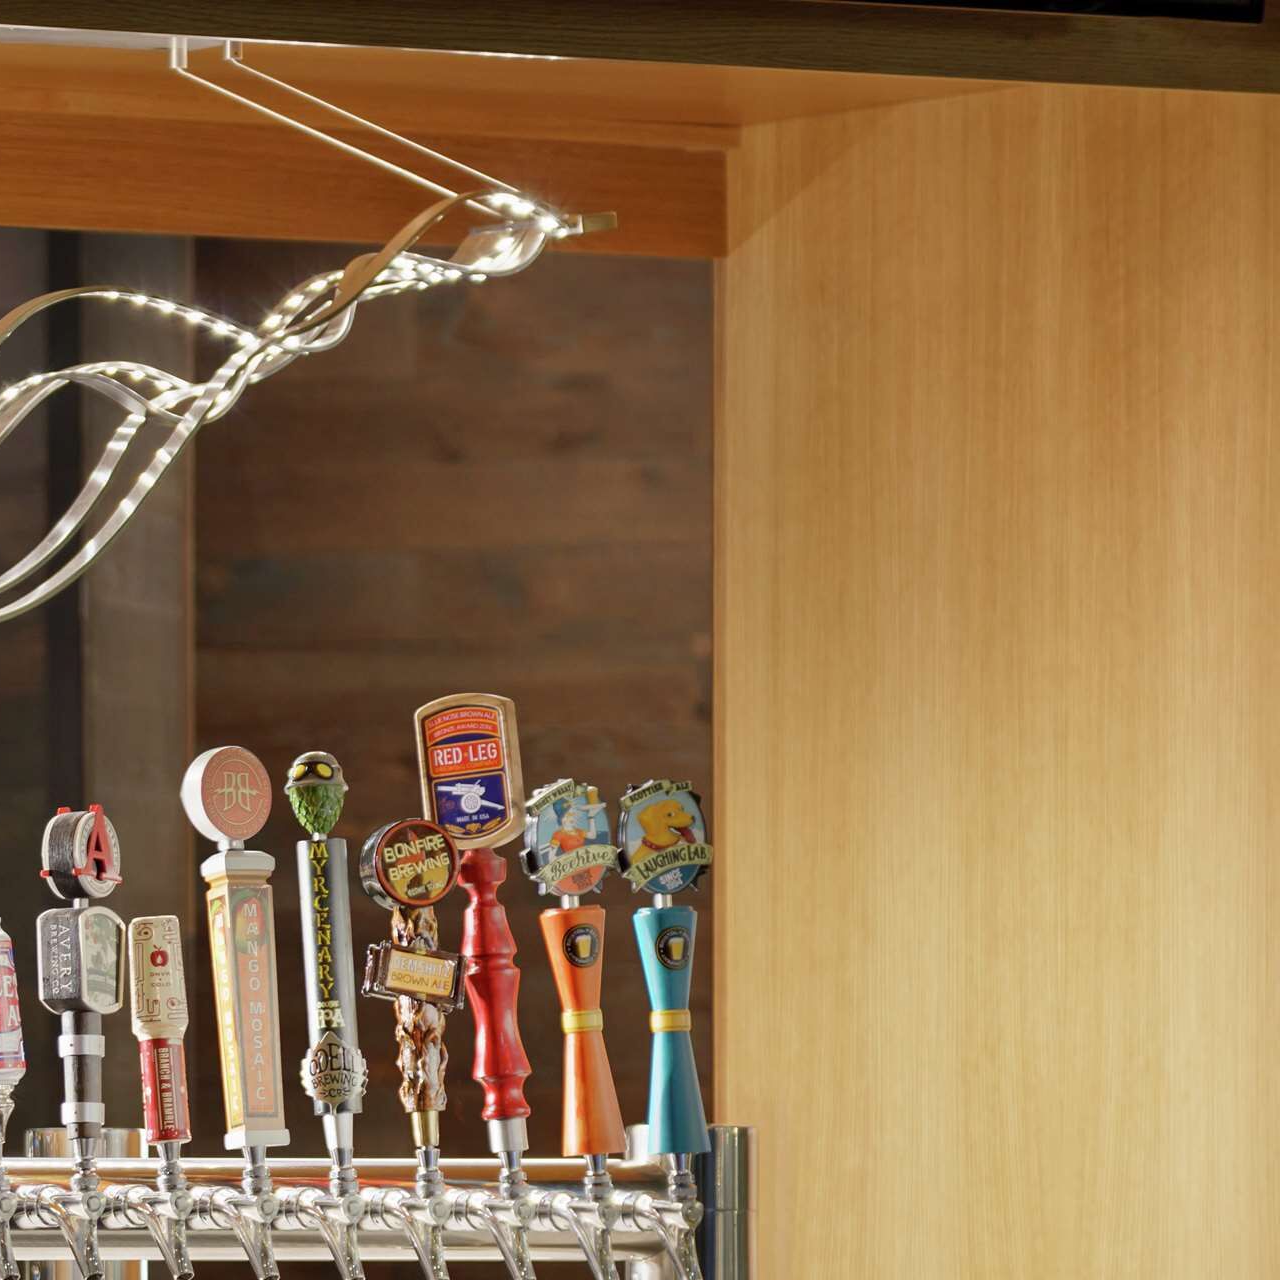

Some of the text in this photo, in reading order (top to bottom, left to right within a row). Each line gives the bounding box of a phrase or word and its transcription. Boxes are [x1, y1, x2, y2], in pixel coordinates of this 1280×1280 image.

[433, 742, 498, 767] RED LEG
[384, 834, 445, 863] BONFIRE
[636, 844, 707, 880] LAUGHING LAB
[389, 852, 450, 881] BREWING
[58, 924, 73, 994] AVERY
[242, 903, 266, 1101] MANGO MOSAIC
[158, 1047, 170, 1078] BRANCH
[311, 1071, 358, 1090] BREWING
[162, 1091, 176, 1131] BRAMBLE
